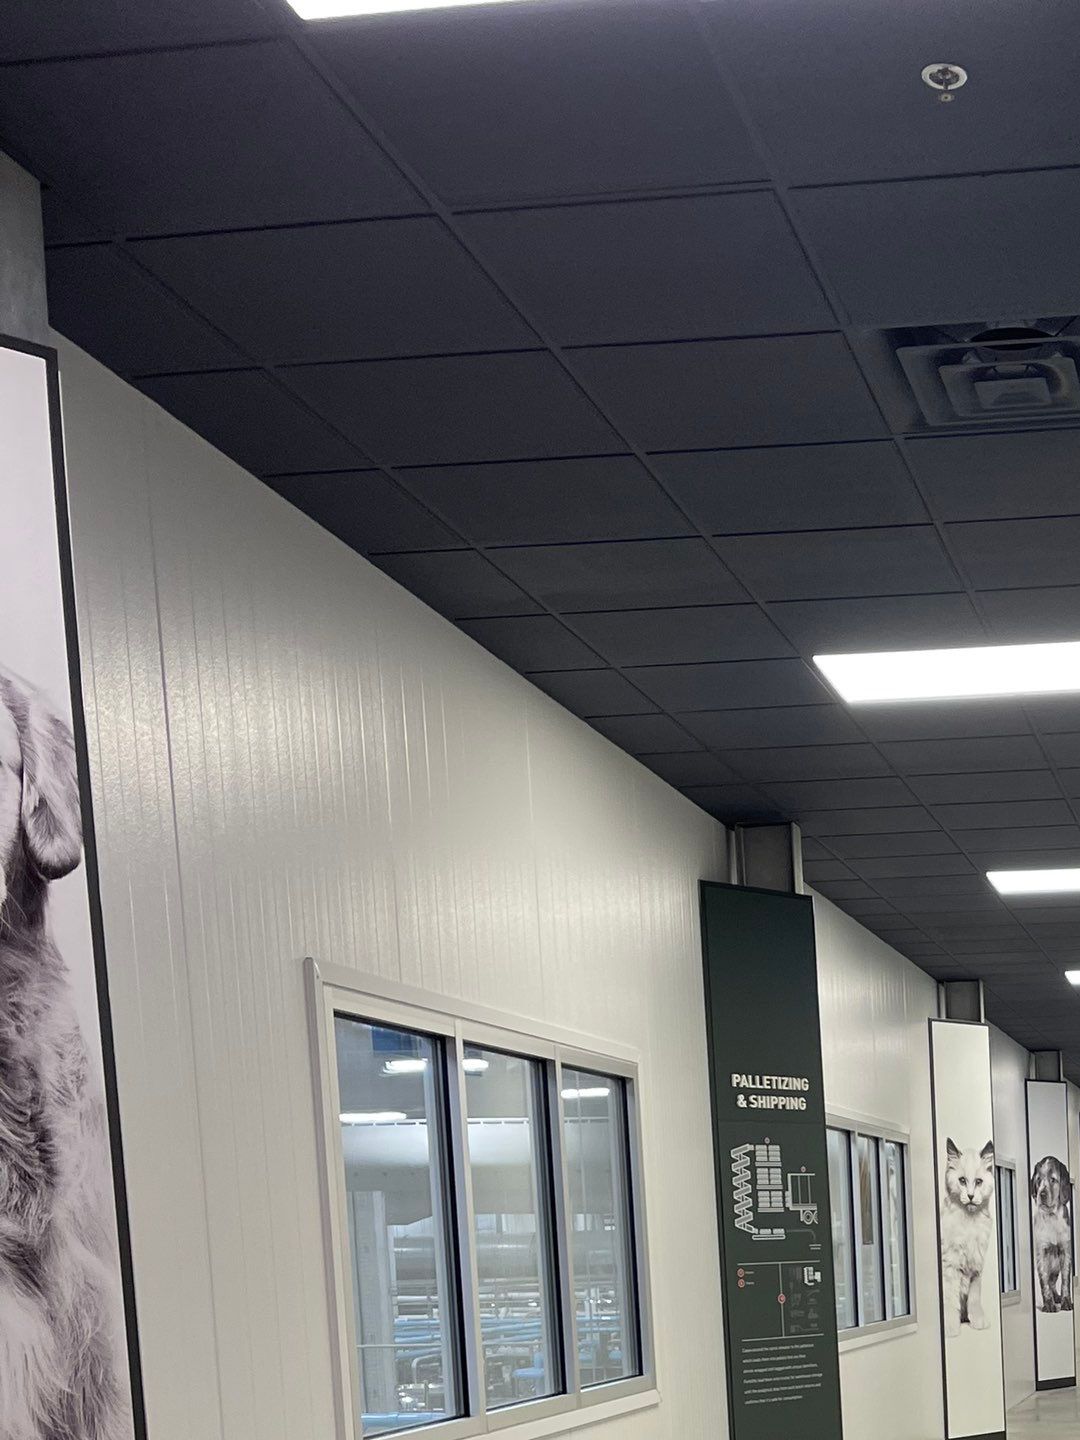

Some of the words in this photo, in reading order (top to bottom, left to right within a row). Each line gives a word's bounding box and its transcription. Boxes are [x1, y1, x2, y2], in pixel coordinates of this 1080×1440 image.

[731, 1073, 810, 1091] PALLETIZING
[736, 1094, 747, 1108] &
[748, 1094, 807, 1111] SHIPPING
